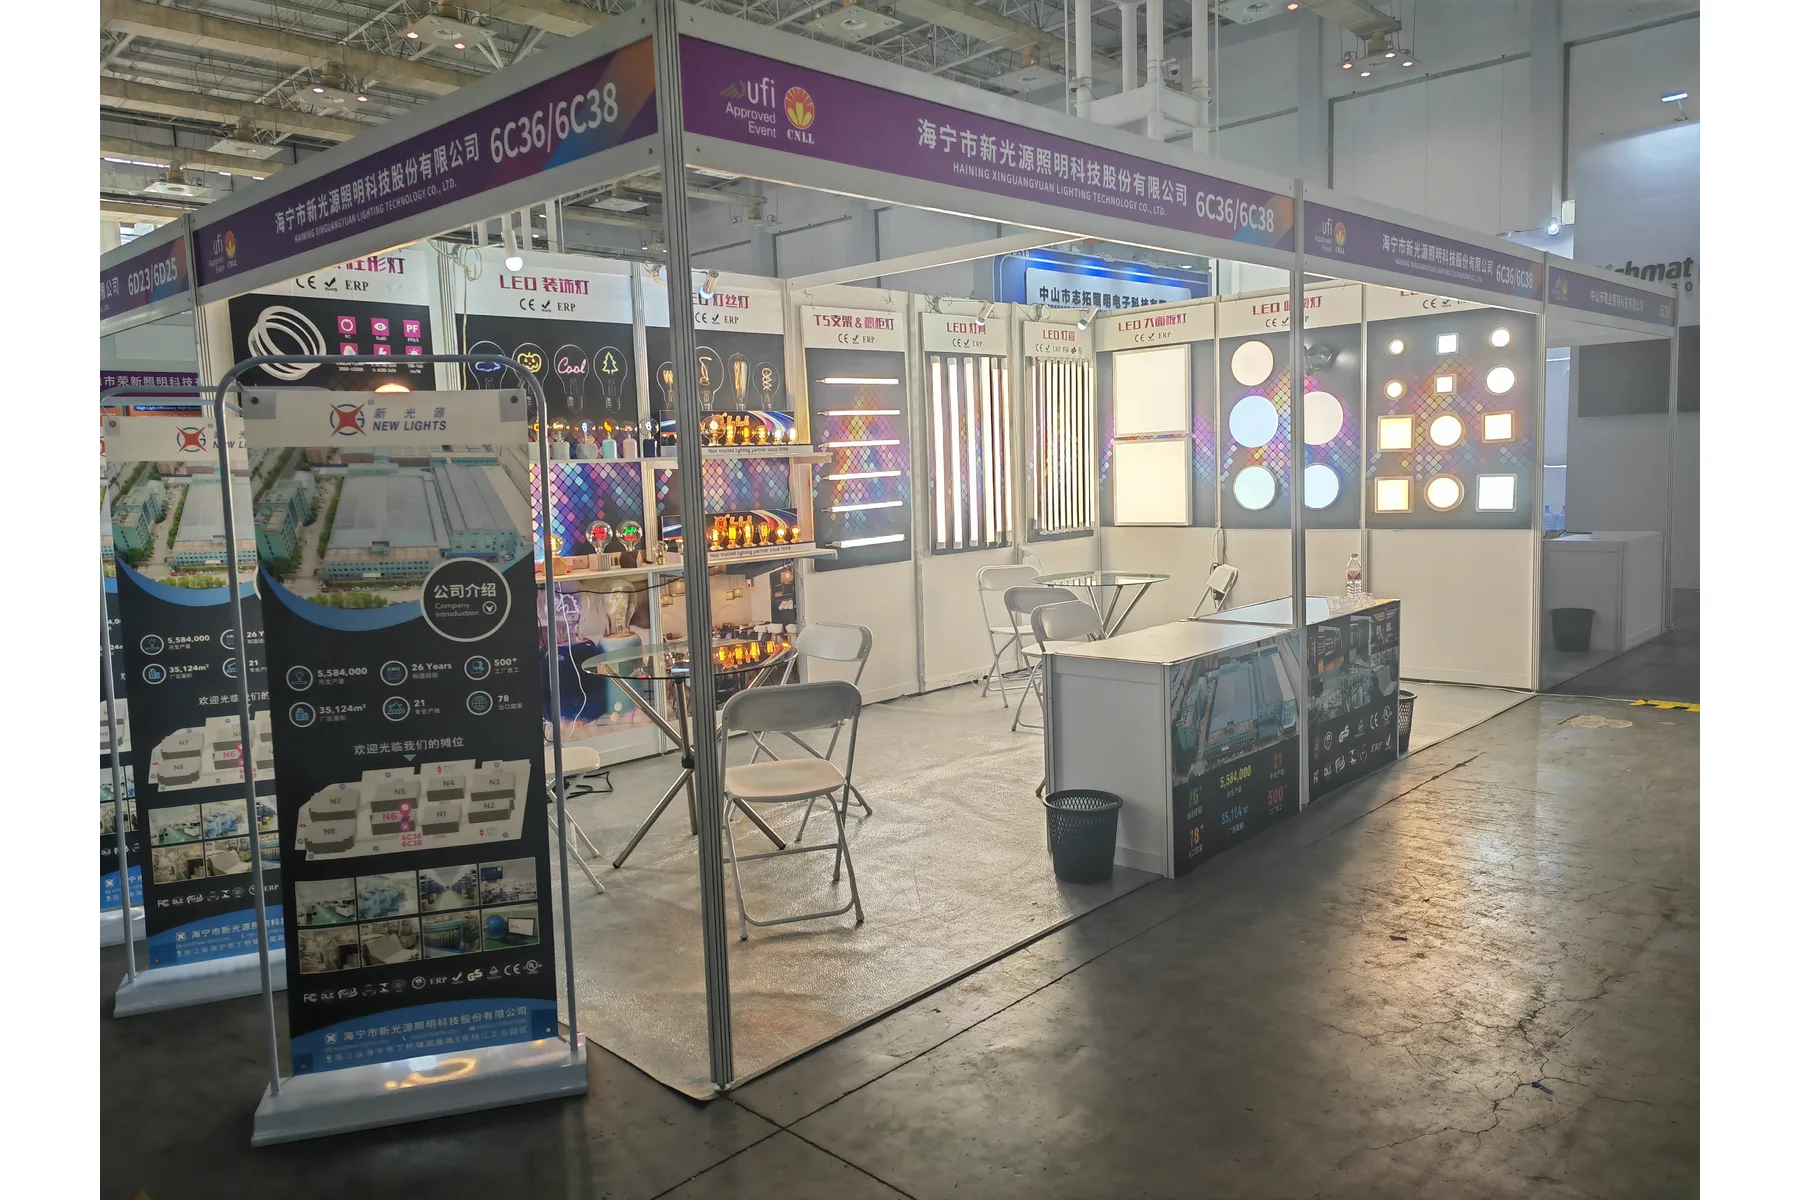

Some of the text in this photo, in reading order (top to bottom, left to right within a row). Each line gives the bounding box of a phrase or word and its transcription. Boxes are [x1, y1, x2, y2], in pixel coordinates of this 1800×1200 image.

[747, 77, 776, 109] ufi
[725, 101, 776, 124] Approved
[490, 82, 619, 163] 6C36/6C38
[748, 121, 777, 139] Event
[787, 128, 815, 145] CNLL
[917, 118, 1275, 232] 海宁市新光源照明科技股份有限公司 6C36/6C38
[275, 132, 480, 234] 海宁市新光源照明科技股份有限公司
[953, 162, 990, 180] HAINING
[991, 169, 1055, 193] XINGUANGYUAN
[1056, 184, 1091, 201] LIGHTING
[1092, 192, 1138, 211] TECHNOLOGY
[1153, 206, 1167, 216] LTD.
[294, 228, 315, 243] HAINING
[315, 215, 356, 236] XINGUANGYUAN
[357, 203, 385, 221] LIGHTING
[385, 189, 426, 211] TECHNOLOGY
[442, 178, 457, 192] LTD.
[1382, 233, 1533, 289] 海宁市新光源照明科技股份有限公司 6C36/6C38
[128, 257, 178, 296] 6D23/6D25
[345, 280, 369, 291] ERP
[500, 274, 590, 295] LED 装饰灯
[557, 302, 576, 312] ERP
[713, 293, 750, 309] 灯丝灯
[1252, 302, 1280, 315] LED
[724, 315, 739, 324] ERP
[854, 317, 863, 329] &
[406, 324, 418, 334] PF
[946, 322, 967, 334] LED
[1118, 320, 1141, 332] LED
[862, 335, 875, 344] ERP
[1042, 329, 1060, 340] LED
[1158, 331, 1172, 339] ERP
[972, 340, 983, 348] ERP
[557, 357, 587, 374] Cool
[374, 407, 446, 419] 新光源
[372, 420, 447, 431] NEW LIGHTS
[433, 582, 497, 599] 公司介绍
[435, 602, 470, 610] Company
[435, 610, 479, 618] Introduction
[167, 635, 210, 644] 5,584,000
[317, 667, 368, 678] 5,584,000
[426, 662, 452, 671] Years
[497, 695, 509, 703] 78
[353, 736, 464, 755] 欢迎光临我们的摊位
[1273, 753, 1282, 770] 21
[489, 778, 501, 786] N3
[1220, 765, 1252, 789] 5,584,000
[329, 797, 341, 805] N7
[483, 802, 495, 810] N2
[382, 812, 397, 821] N6
[323, 827, 336, 835] N8
[401, 833, 423, 841] 6C36
[429, 977, 448, 985] ERP
[467, 969, 483, 982] GS
[344, 1006, 527, 1041] 海宁市新光源照明科技股份有限公司
